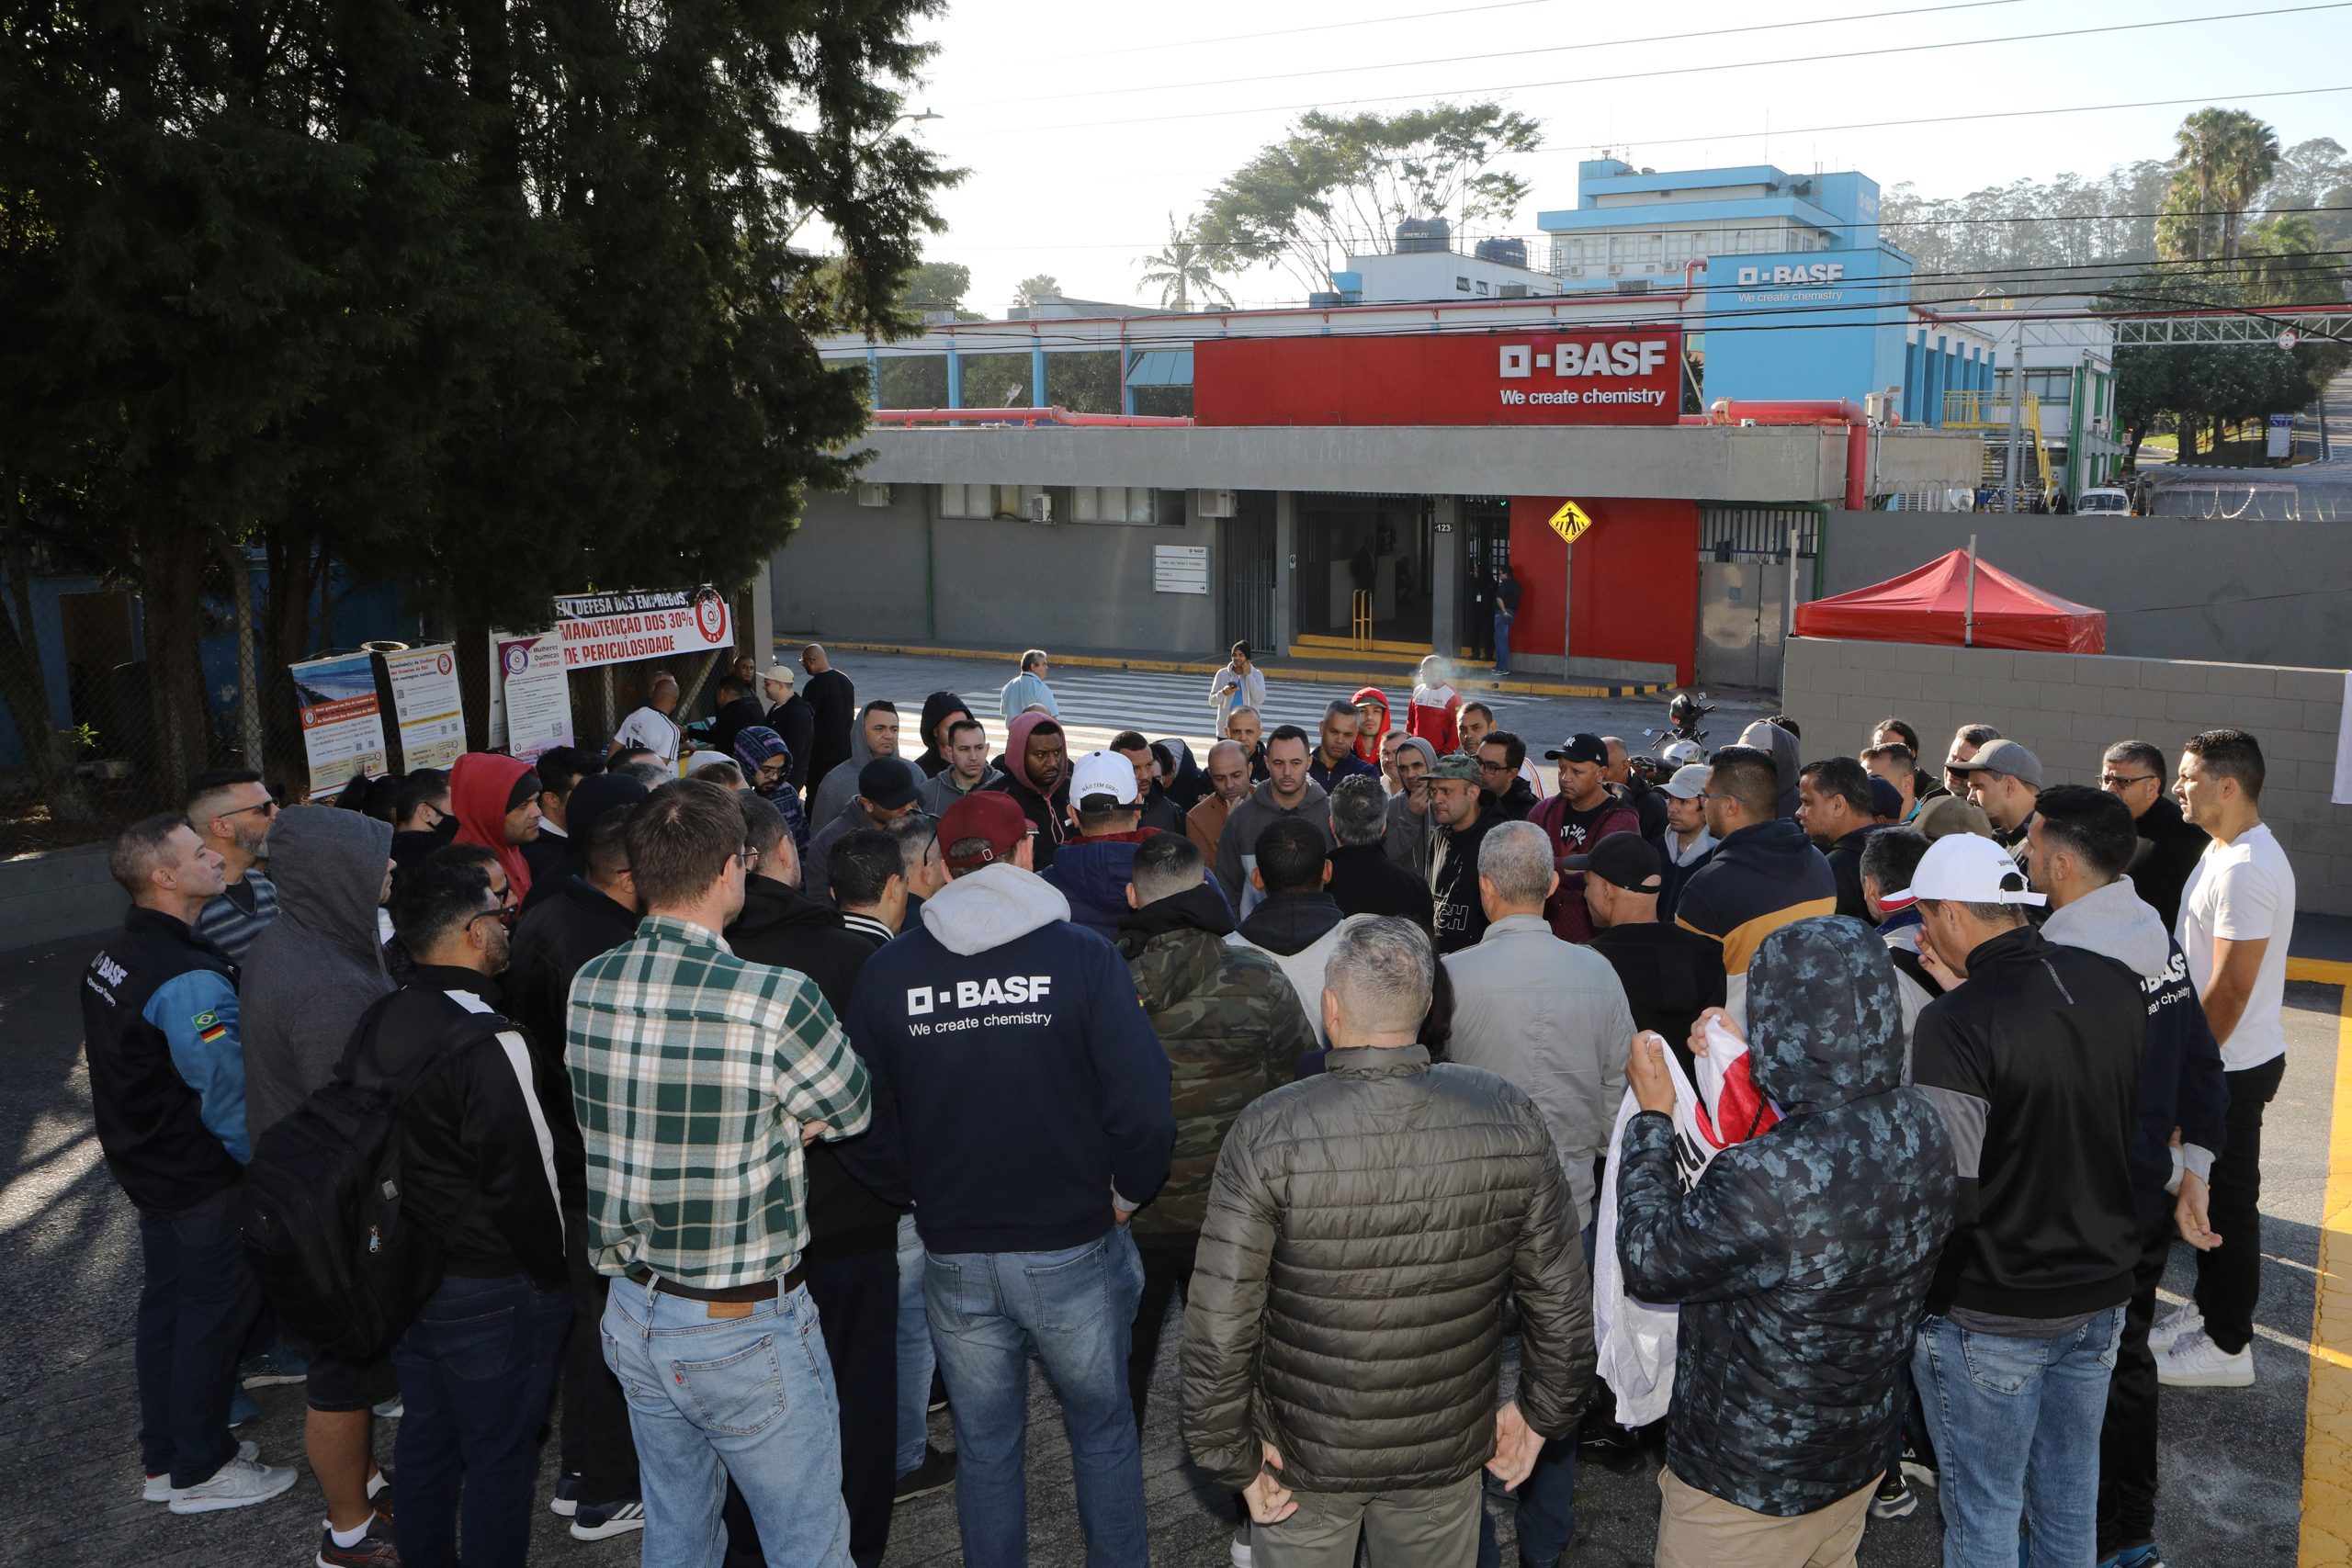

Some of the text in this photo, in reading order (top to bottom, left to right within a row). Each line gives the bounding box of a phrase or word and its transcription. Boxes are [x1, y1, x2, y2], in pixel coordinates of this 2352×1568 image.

[1773, 264, 1844, 286] BASF
[1738, 290, 1843, 303] We create chemistry
[1555, 340, 1667, 377] BASF
[1499, 387, 1666, 406] We create chemistry
[1437, 524, 1451, 532] 123
[577, 597, 613, 615] DEFESA
[616, 595, 634, 613] DOS
[637, 592, 689, 610] EMPREGOS,
[644, 614, 666, 632] DOS
[669, 610, 695, 629] 30%
[533, 645, 559, 653] Mulheres
[564, 635, 675, 665] DE PERICULOSIDADE
[1081, 782, 1093, 793] NÃO
[1104, 784, 1119, 794] ERRO
[97, 955, 128, 987] BASF
[956, 976, 1051, 1009] BASF
[908, 1011, 1053, 1036] We create chemistry
